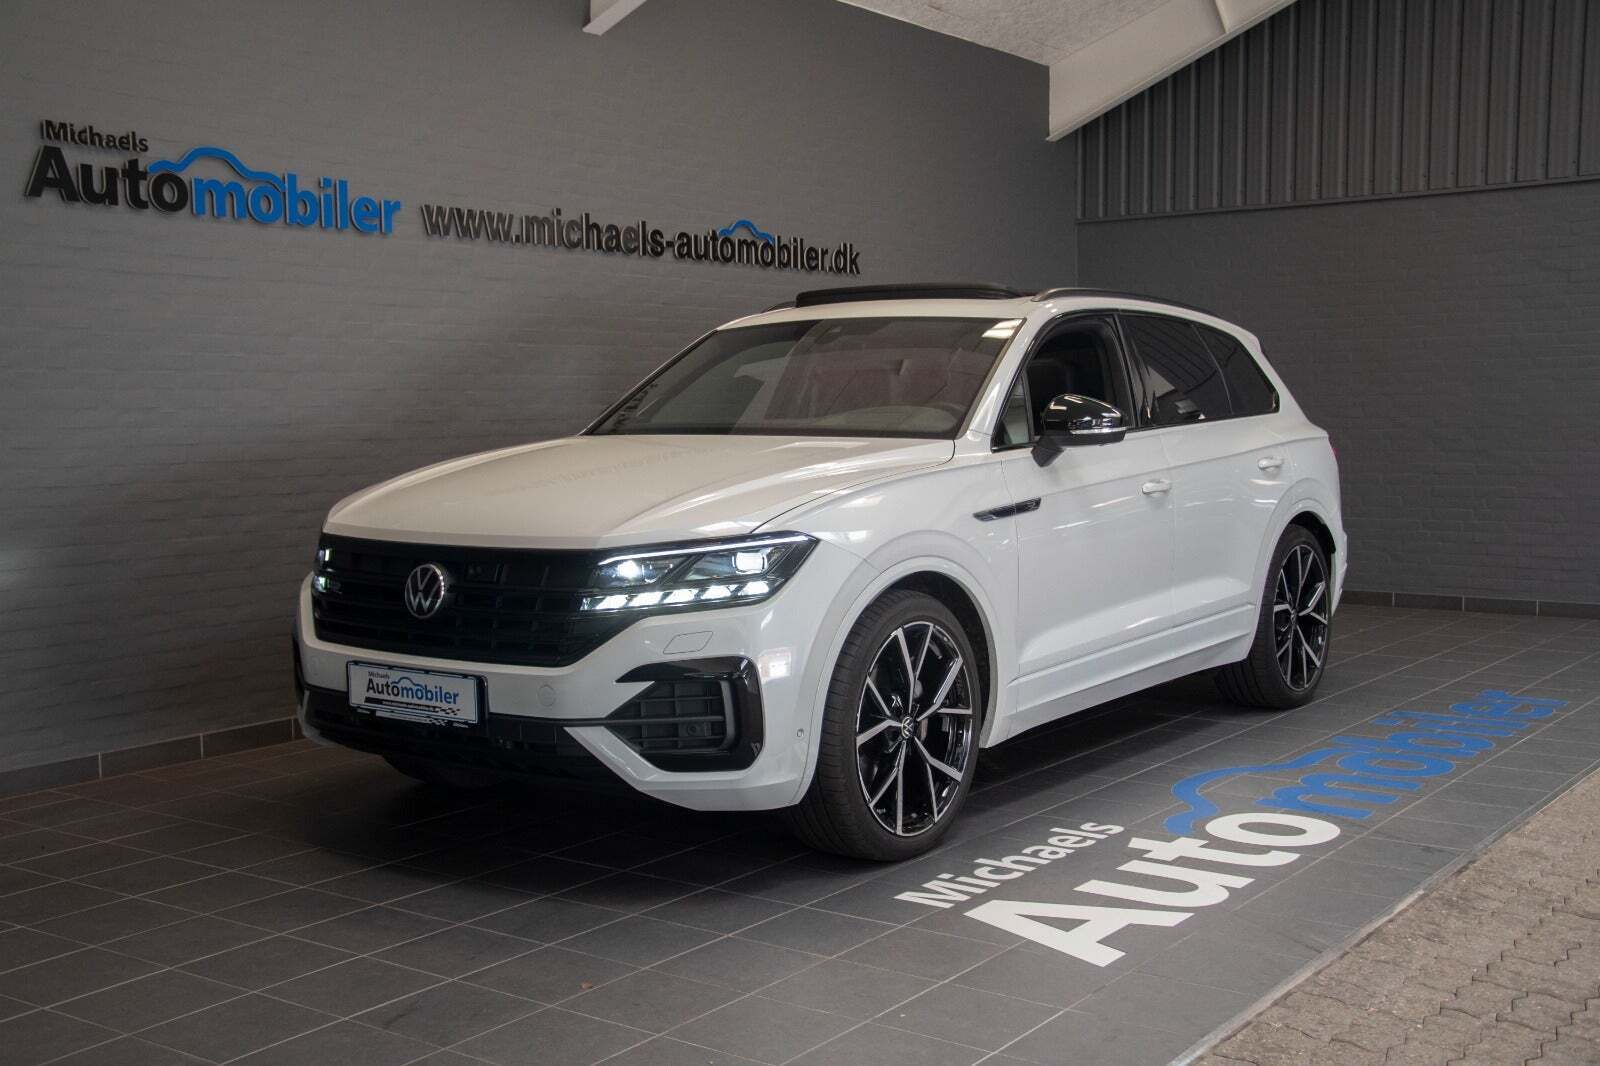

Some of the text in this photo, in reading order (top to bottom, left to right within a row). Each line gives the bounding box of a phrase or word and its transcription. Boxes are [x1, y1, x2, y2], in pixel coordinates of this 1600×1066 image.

[40, 118, 149, 153] Michaels
[24, 145, 402, 236] Automobiler
[420, 203, 860, 276] www.michaels-automobiler.dk
[366, 678, 459, 705] Automobiler
[894, 819, 1125, 909] Michaels
[963, 689, 1570, 968] Automobiler
